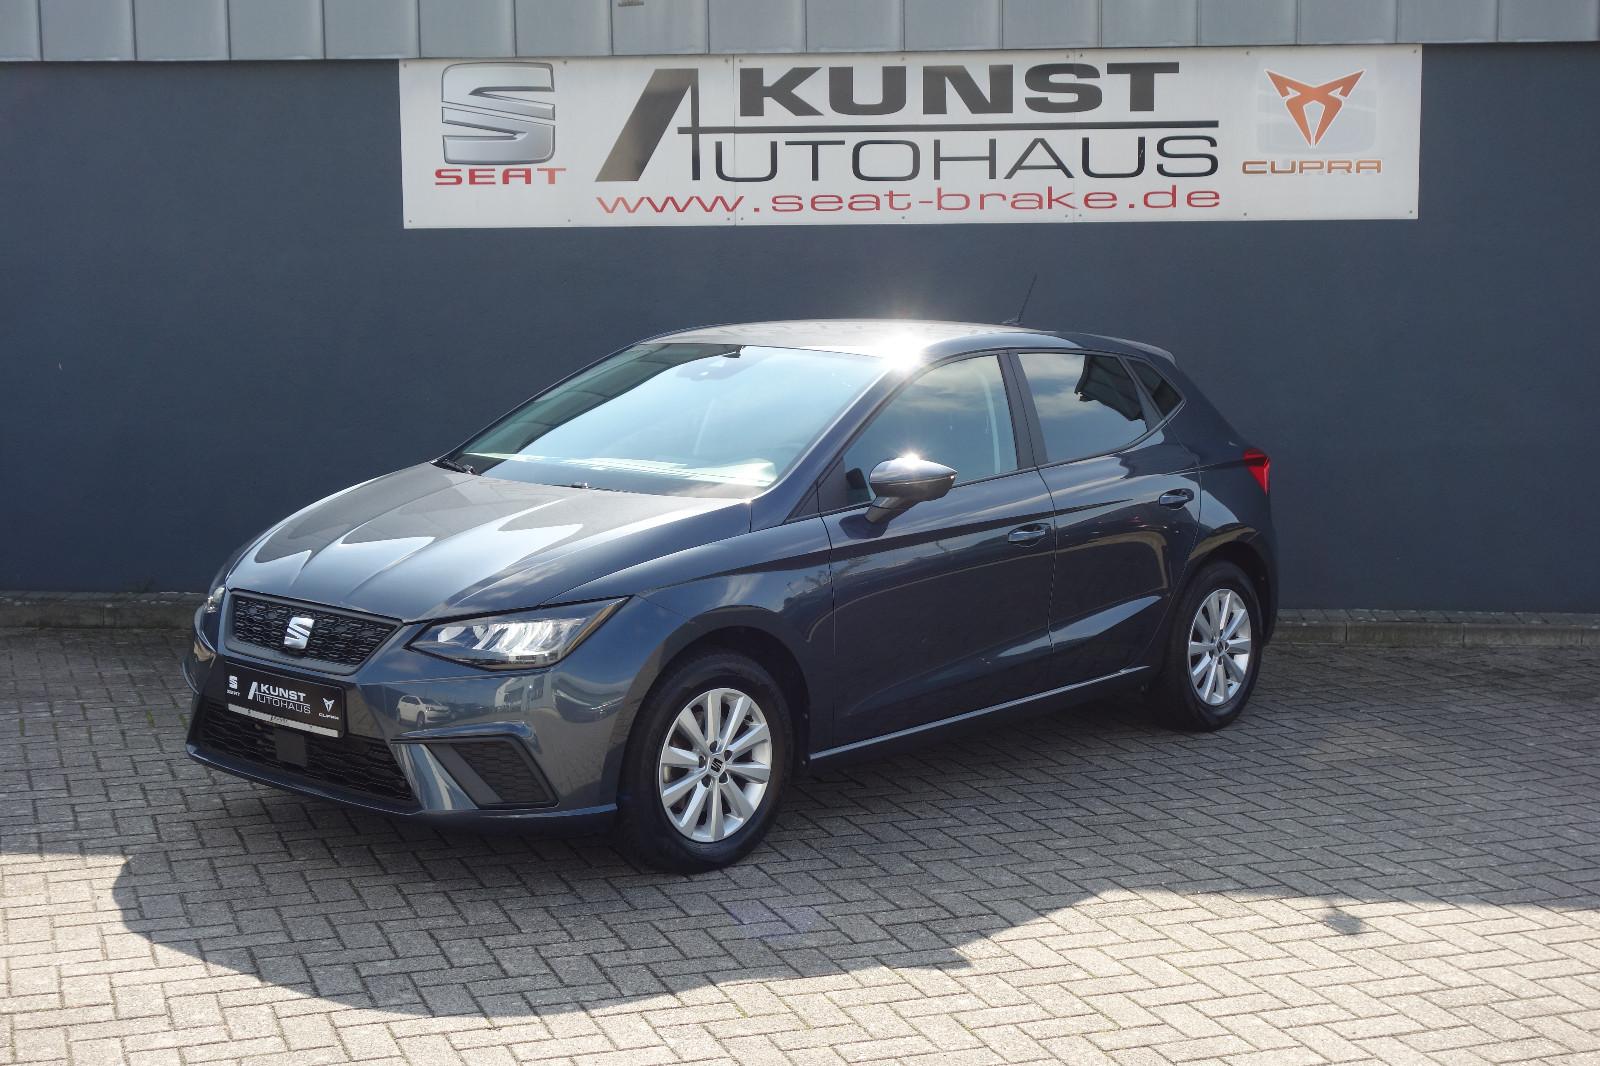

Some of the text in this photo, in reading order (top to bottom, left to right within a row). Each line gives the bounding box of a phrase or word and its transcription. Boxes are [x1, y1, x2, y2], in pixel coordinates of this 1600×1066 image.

[740, 62, 1180, 117] KUNST
[1241, 158, 1382, 175] CUPRA
[434, 167, 567, 186] SEAT
[596, 184, 1221, 214] www.seat-brake.de
[261, 684, 306, 701] KUNST
